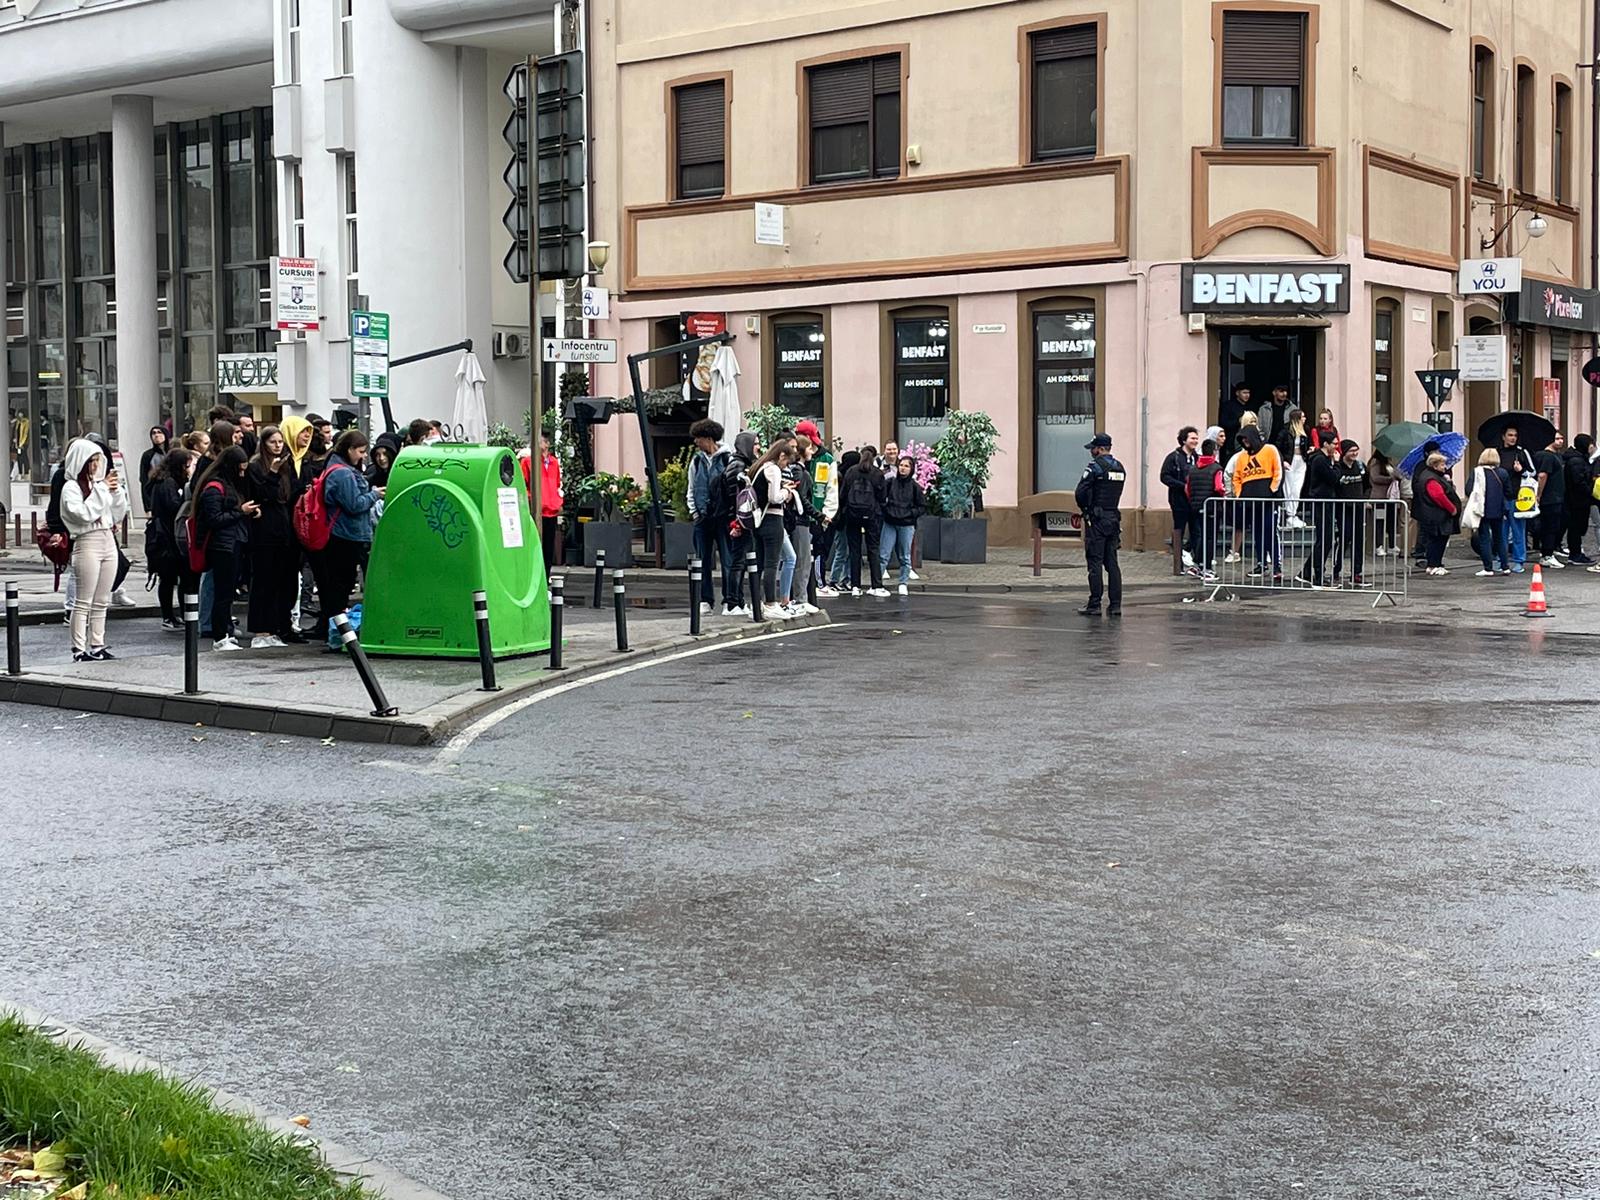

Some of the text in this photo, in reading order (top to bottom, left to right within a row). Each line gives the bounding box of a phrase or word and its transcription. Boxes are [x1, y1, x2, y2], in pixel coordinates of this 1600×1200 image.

[279, 268, 315, 277] CURSURI
[1484, 264, 1495, 275] 4
[1193, 273, 1343, 303] BENFAST
[1473, 278, 1506, 290] YOU
[584, 292, 592, 302] 4
[583, 305, 600, 316] OU
[358, 316, 369, 334] P
[561, 341, 608, 351] Infocentru
[1042, 340, 1088, 354] BENFAST
[571, 352, 599, 361] turistic
[781, 349, 821, 362] BENFAST
[902, 345, 945, 359] BENFAST
[783, 381, 793, 389] AM
[904, 379, 944, 387] AM DESCHIS!
[1046, 376, 1057, 384] AM
[1046, 415, 1086, 426] BENFAST
[1242, 467, 1266, 479] adidas
